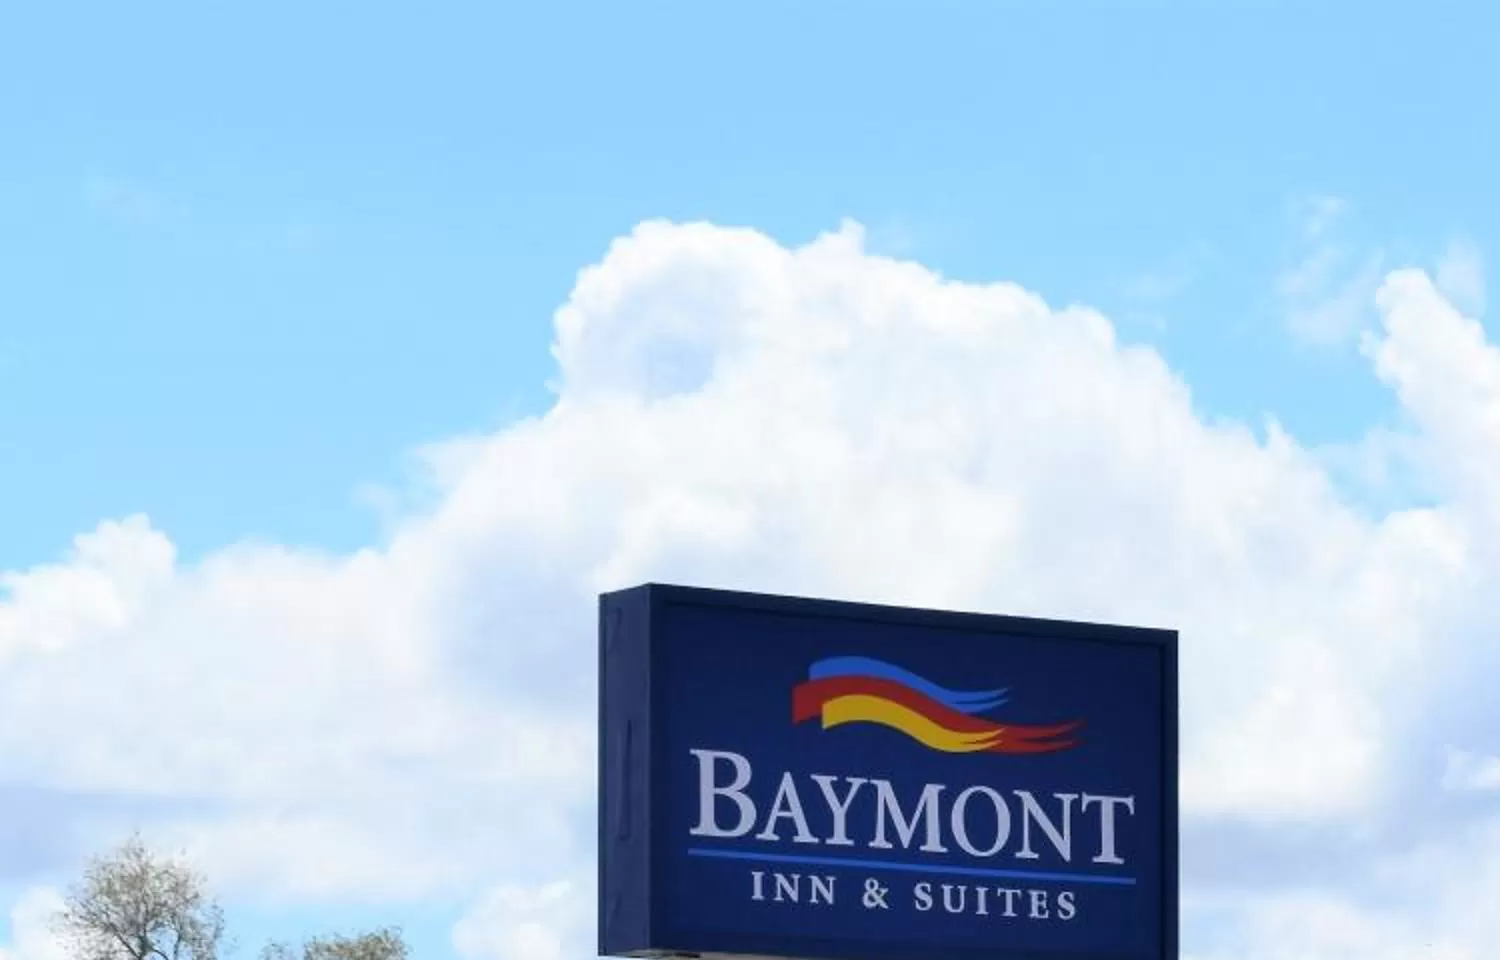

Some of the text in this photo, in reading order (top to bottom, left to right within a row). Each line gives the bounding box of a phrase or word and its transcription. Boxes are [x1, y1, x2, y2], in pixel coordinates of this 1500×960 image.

[689, 748, 1136, 865] BAYMONT
[751, 871, 1077, 920] INN & SUITES
